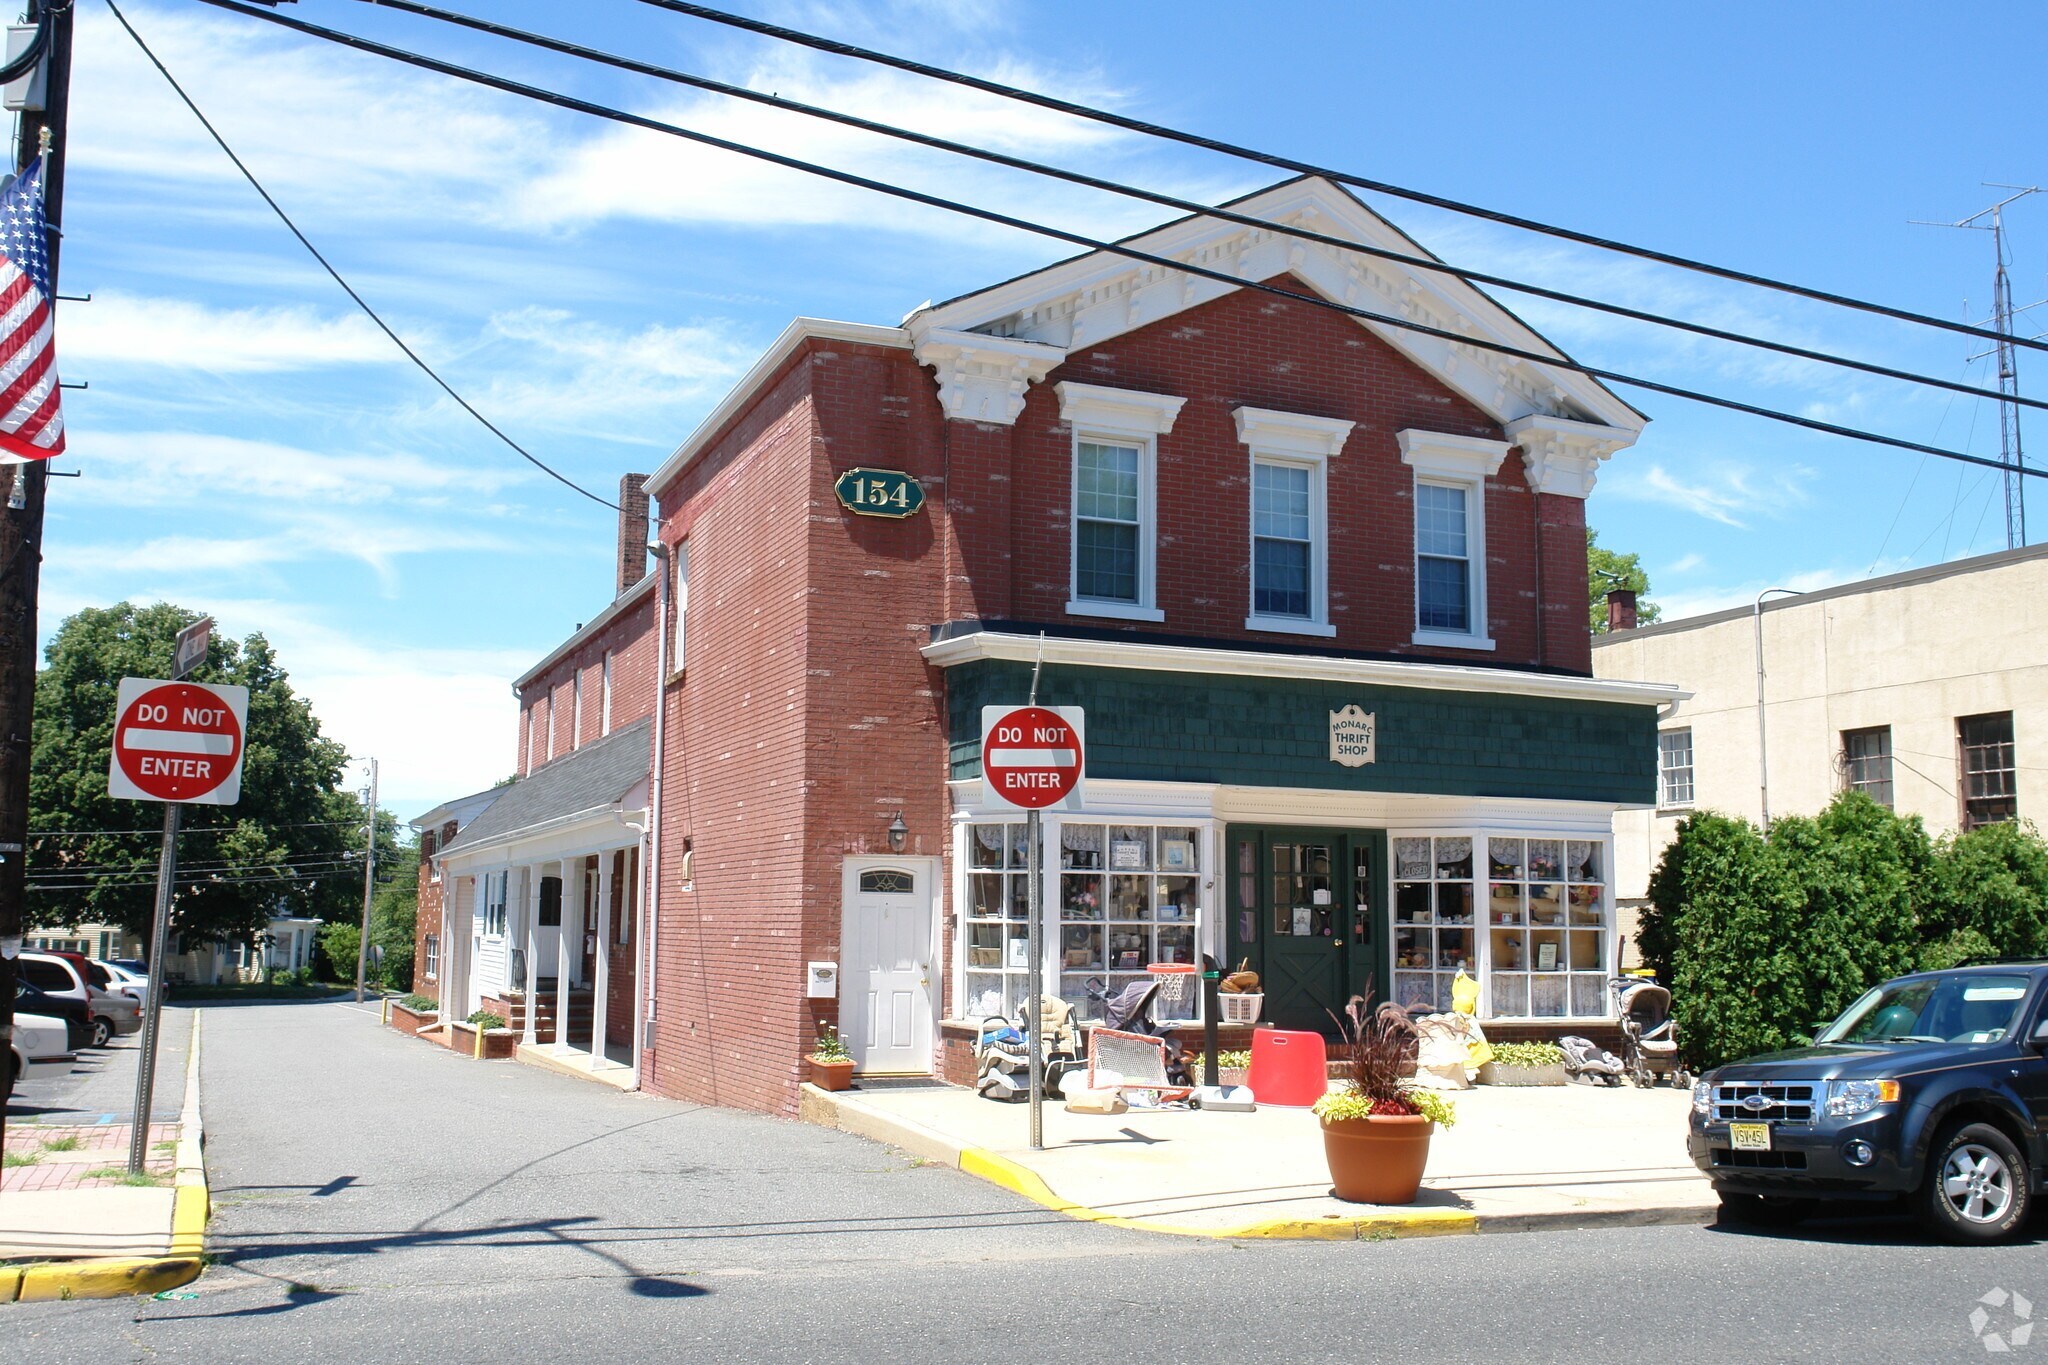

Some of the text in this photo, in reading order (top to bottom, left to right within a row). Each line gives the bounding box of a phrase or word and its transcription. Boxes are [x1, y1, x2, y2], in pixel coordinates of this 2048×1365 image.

[852, 477, 910, 508] 154
[137, 704, 226, 727] DO NOT
[998, 727, 1067, 743] DO NOT
[1332, 720, 1373, 734] MONARC
[1335, 732, 1370, 744] THRIFT
[1338, 744, 1368, 755] SHOP
[140, 757, 211, 780] ENTER
[1005, 772, 1061, 788] ENTER
[1404, 865, 1428, 877] CLOSED
